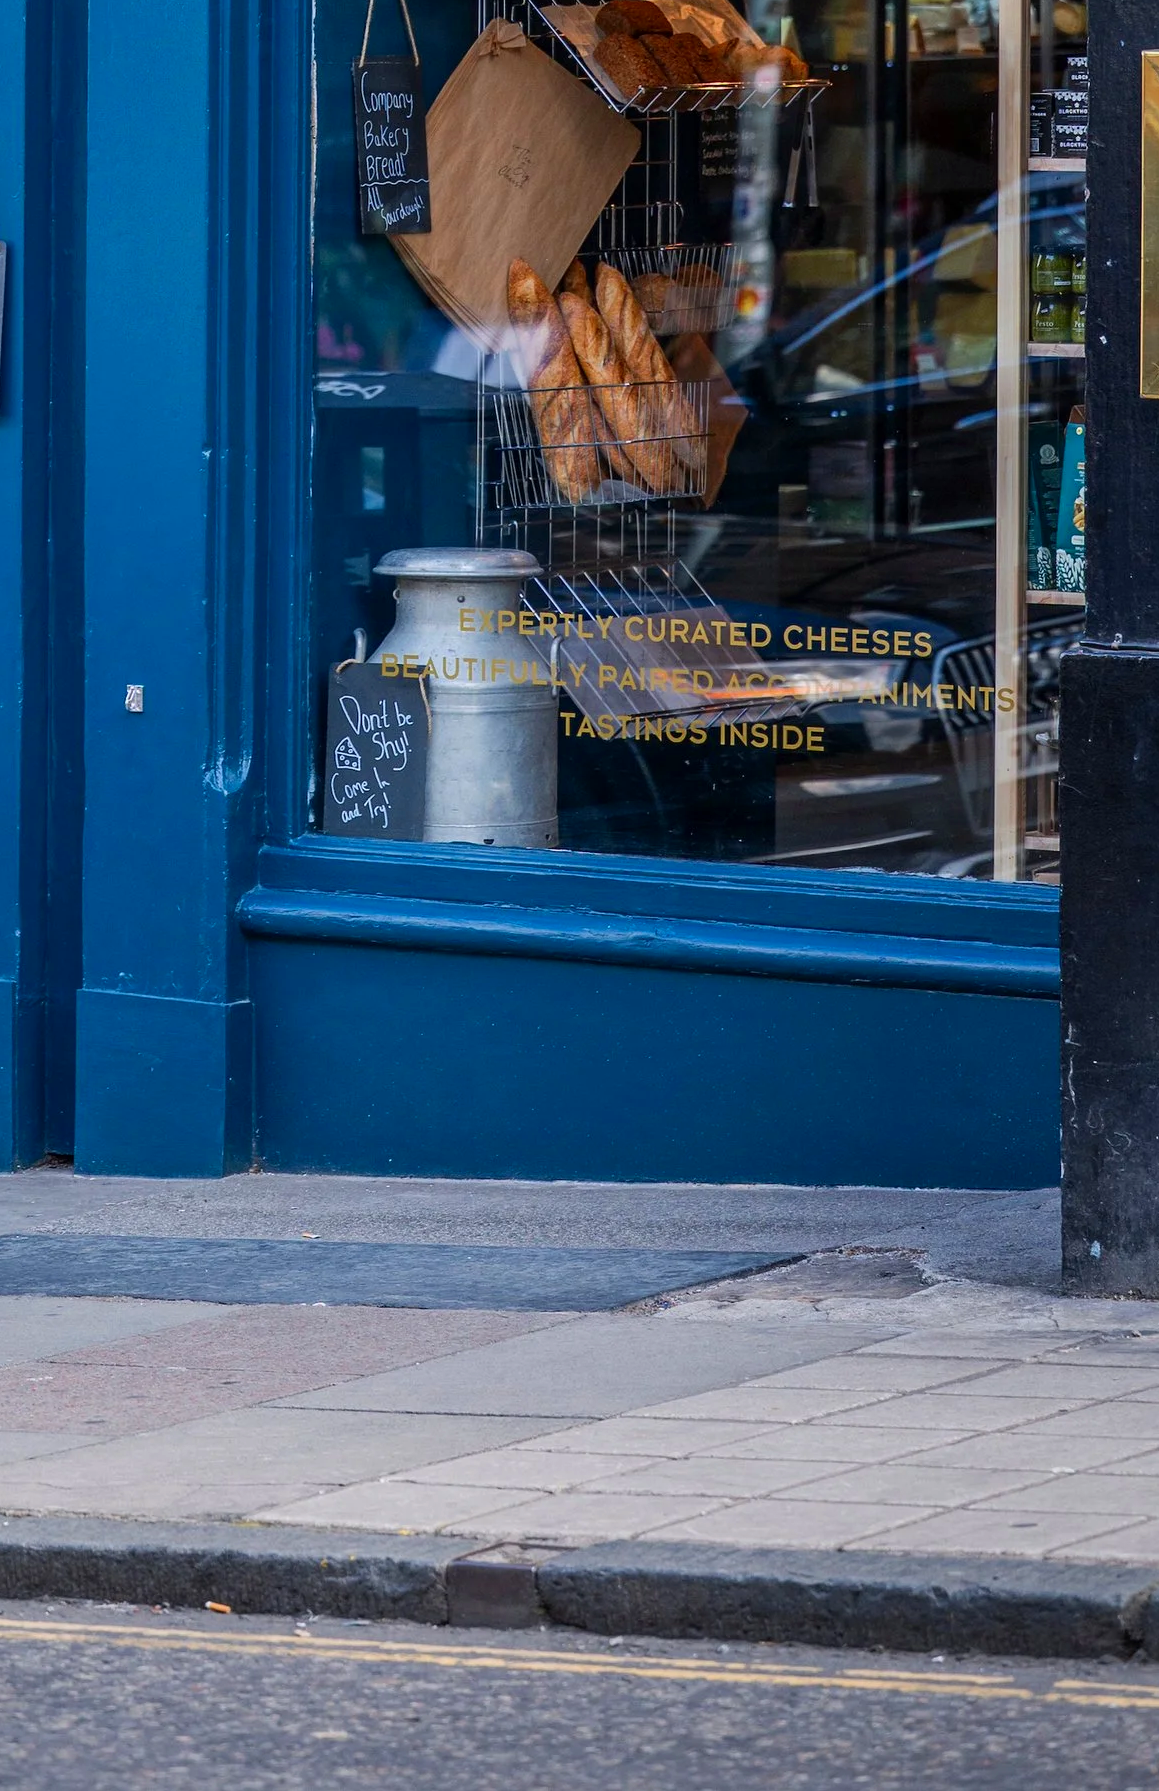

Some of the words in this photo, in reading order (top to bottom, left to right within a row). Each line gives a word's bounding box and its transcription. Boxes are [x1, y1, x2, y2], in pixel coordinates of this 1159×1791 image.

[361, 71, 413, 123] Company
[364, 120, 409, 156] Bakery
[366, 152, 407, 182] Bread!
[367, 186, 384, 212] All
[459, 608, 614, 640] EXPERTLY
[624, 617, 772, 648] CURATED
[783, 625, 933, 658] CHEESES
[381, 653, 586, 688] BEAUTIFULLY
[598, 664, 714, 695] PAIRED
[339, 695, 390, 735] Don't
[394, 702, 414, 727] be
[560, 712, 708, 745] TASTINGS
[719, 722, 825, 752] INSIDE
[372, 731, 413, 771] Shy!
[331, 772, 370, 805] Come
[341, 803, 362, 823] and
[364, 792, 392, 828] Try!
